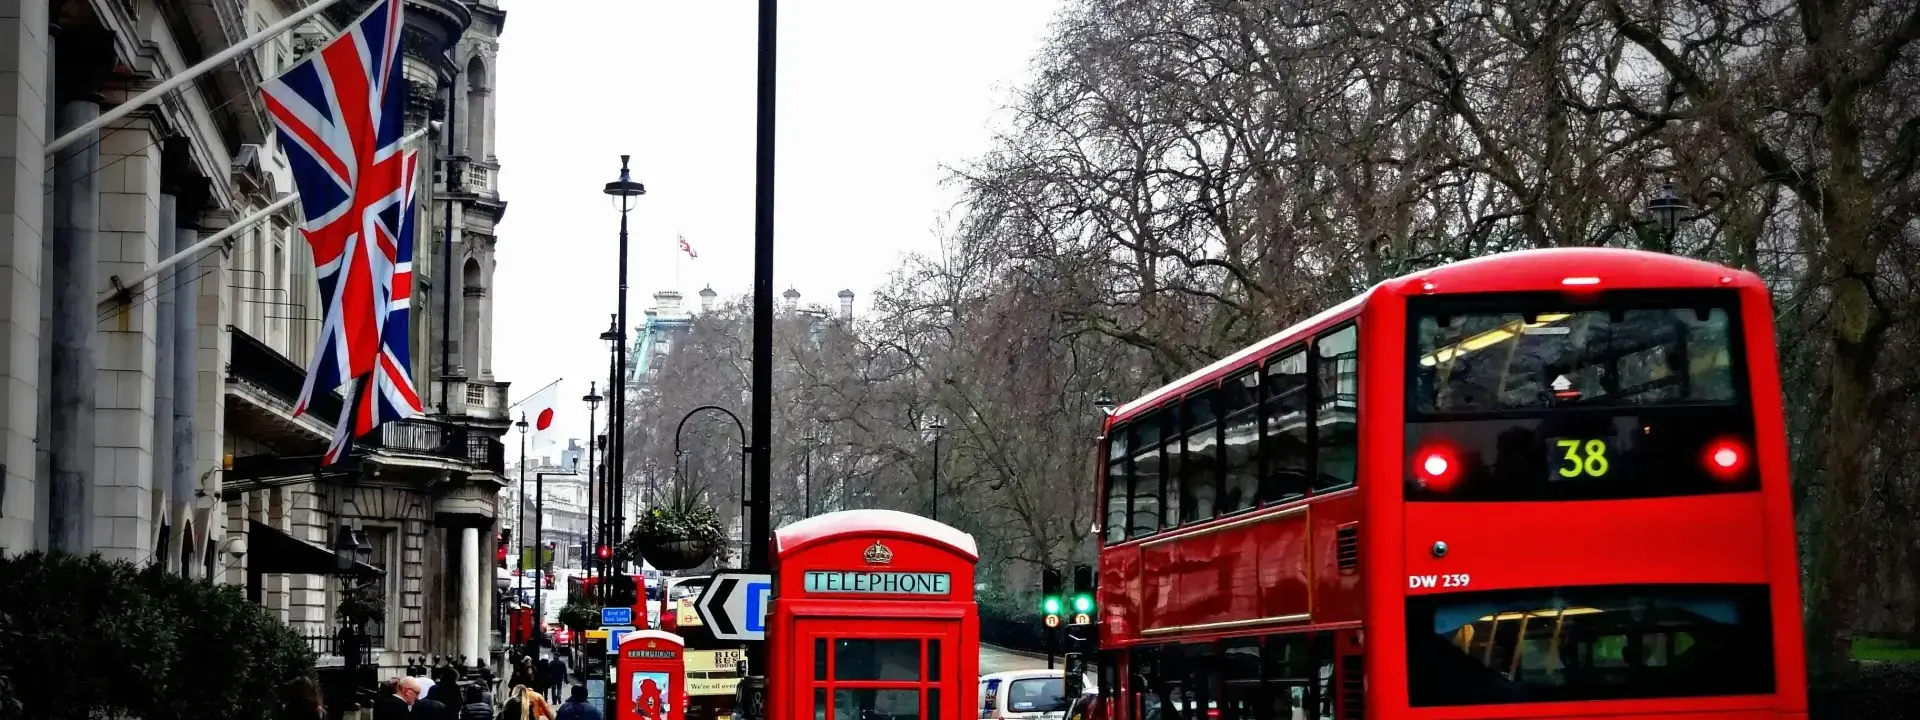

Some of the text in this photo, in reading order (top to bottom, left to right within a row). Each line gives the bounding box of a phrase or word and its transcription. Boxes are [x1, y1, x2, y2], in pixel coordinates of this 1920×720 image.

[1557, 439, 1608, 477] 38
[809, 572, 945, 592] TELEPHONE
[1409, 573, 1470, 588] DW 239
[629, 650, 675, 658] TELEPHONE
[715, 657, 738, 665] BUS
